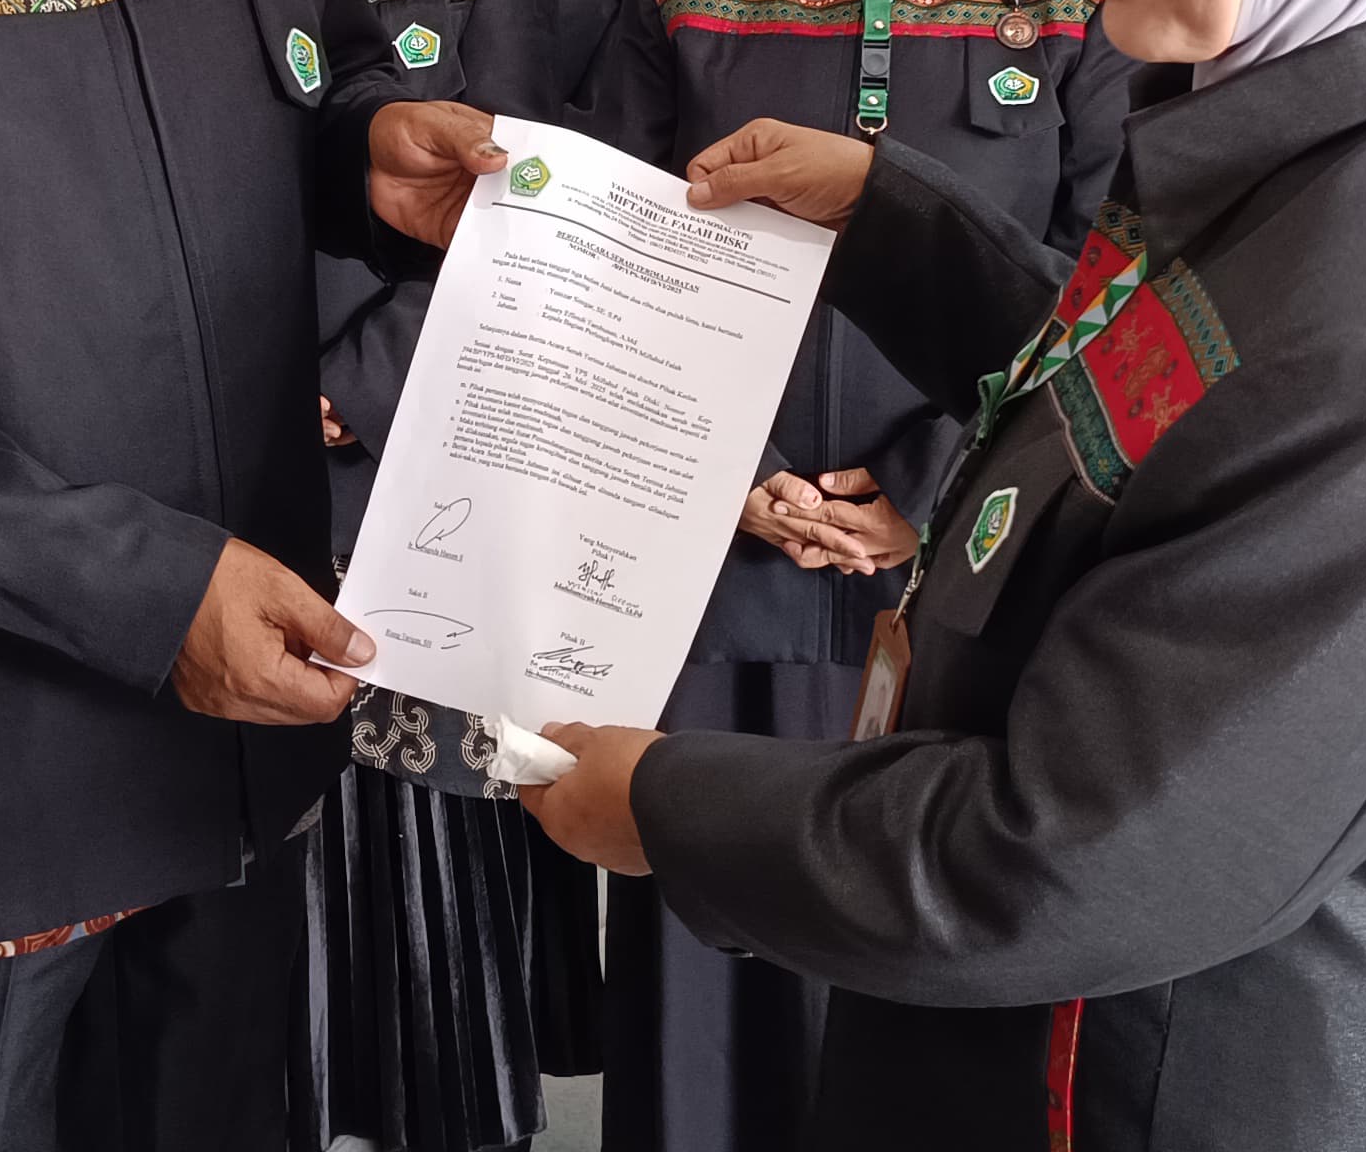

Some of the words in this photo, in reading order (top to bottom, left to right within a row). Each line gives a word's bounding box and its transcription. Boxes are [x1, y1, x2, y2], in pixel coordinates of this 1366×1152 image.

[607, 191, 669, 225] MIFTAHUL
[671, 219, 713, 239] FALAH
[714, 232, 749, 251] DISKI
[611, 181, 645, 202] YAYASAN
[644, 197, 689, 220] PENDIDIKAN
[689, 214, 706, 225] DAN
[706, 220, 732, 234] SOSIAL
[555, 230, 586, 249] BERITA
[585, 241, 611, 258] ACARA
[610, 253, 635, 269] SERAH
[635, 264, 665, 282] TERIMA
[665, 276, 700, 294] JABATAN
[568, 243, 596, 259] NOMOR
